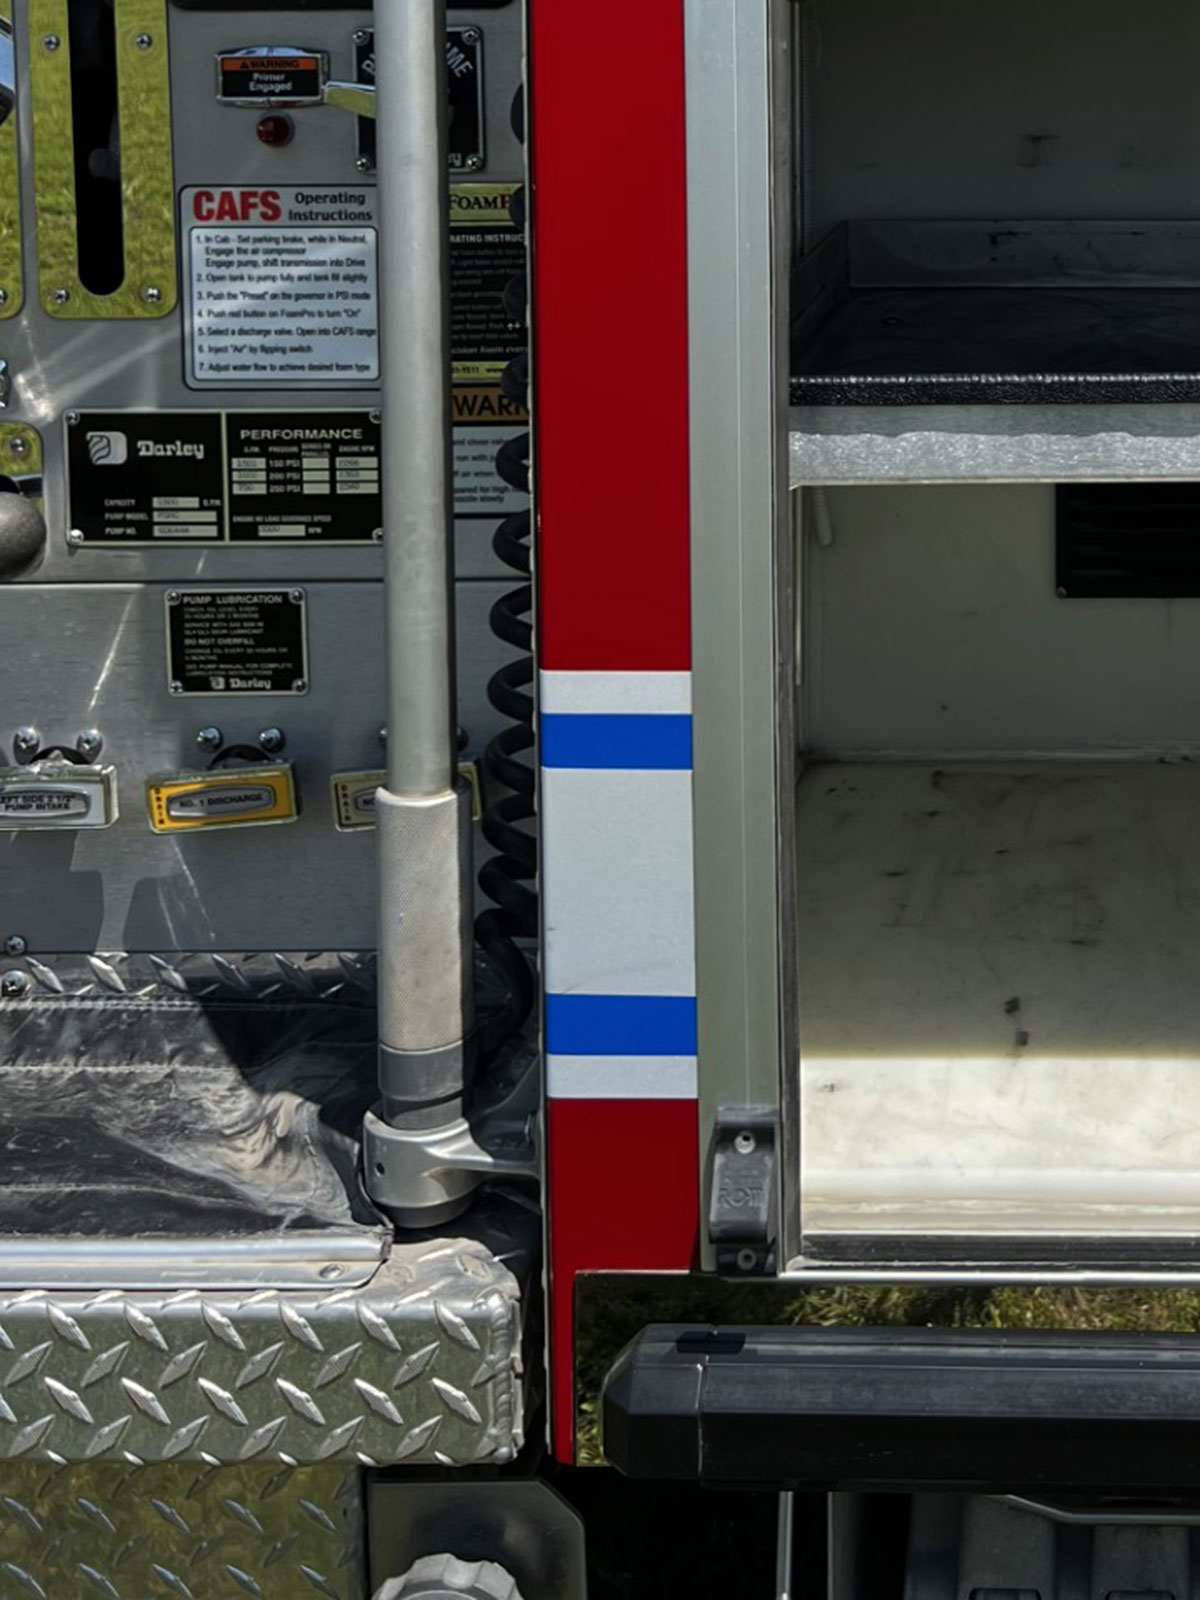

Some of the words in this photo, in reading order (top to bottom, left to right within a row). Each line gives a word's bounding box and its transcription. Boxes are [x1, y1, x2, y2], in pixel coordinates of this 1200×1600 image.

[251, 59, 300, 69] WARNING
[253, 72, 286, 82] Primer
[249, 81, 293, 92] Engaged
[193, 190, 282, 222] CAFS
[294, 192, 366, 207] Operating
[288, 209, 373, 222] Instructions
[252, 234, 280, 245] parking
[307, 234, 327, 244] while
[205, 247, 234, 256] Engage
[236, 247, 249, 255] the
[262, 247, 306, 256] compressor
[205, 258, 235, 268] Engage
[280, 258, 327, 267] transmission
[345, 258, 366, 267] Drive
[206, 273, 227, 283] Open
[228, 273, 245, 282] tank
[256, 273, 278, 284] pump
[279, 273, 295, 283] fully
[297, 273, 312, 282] and
[313, 273, 329, 282] tank
[341, 273, 368, 283] slightly
[206, 291, 225, 300] Push
[226, 291, 238, 300] the
[281, 291, 293, 300] the
[294, 292, 326, 302] governor
[350, 291, 371, 300] mode
[207, 309, 226, 318] Push
[228, 309, 241, 318] red
[242, 309, 267, 318] button
[325, 309, 342, 318] turn
[207, 327, 229, 337] Select
[237, 327, 272, 338] discharge
[295, 327, 316, 338] Open
[332, 327, 354, 337] CAFS
[355, 328, 377, 338] range
[208, 344, 229, 354] Inject
[259, 344, 288, 355] flipping
[288, 344, 313, 354] switch
[208, 363, 231, 373] Adjust
[232, 363, 252, 372] water
[278, 363, 306, 372] achieve
[307, 363, 334, 372] desired
[334, 363, 353, 372] foam
[354, 364, 371, 373] type
[240, 428, 363, 440] PERFORMANCE
[137, 440, 204, 459] Darley
[269, 459, 284, 467] 150
[286, 459, 300, 467] PSI
[269, 472, 284, 480] 200
[286, 472, 300, 480] PSI
[269, 484, 284, 493] 250
[286, 484, 300, 493] PSI
[104, 498, 135, 506] CAPACITY
[104, 512, 124, 520] PUMP
[125, 512, 149, 520] MODEL
[183, 596, 212, 604] PUMP
[216, 595, 282, 604] LUBRICATION
[229, 677, 271, 690] Darley
[208, 793, 264, 805] DISCHARGE
[5, 803, 33, 811] PUMP
[36, 802, 71, 810] INTAKE
